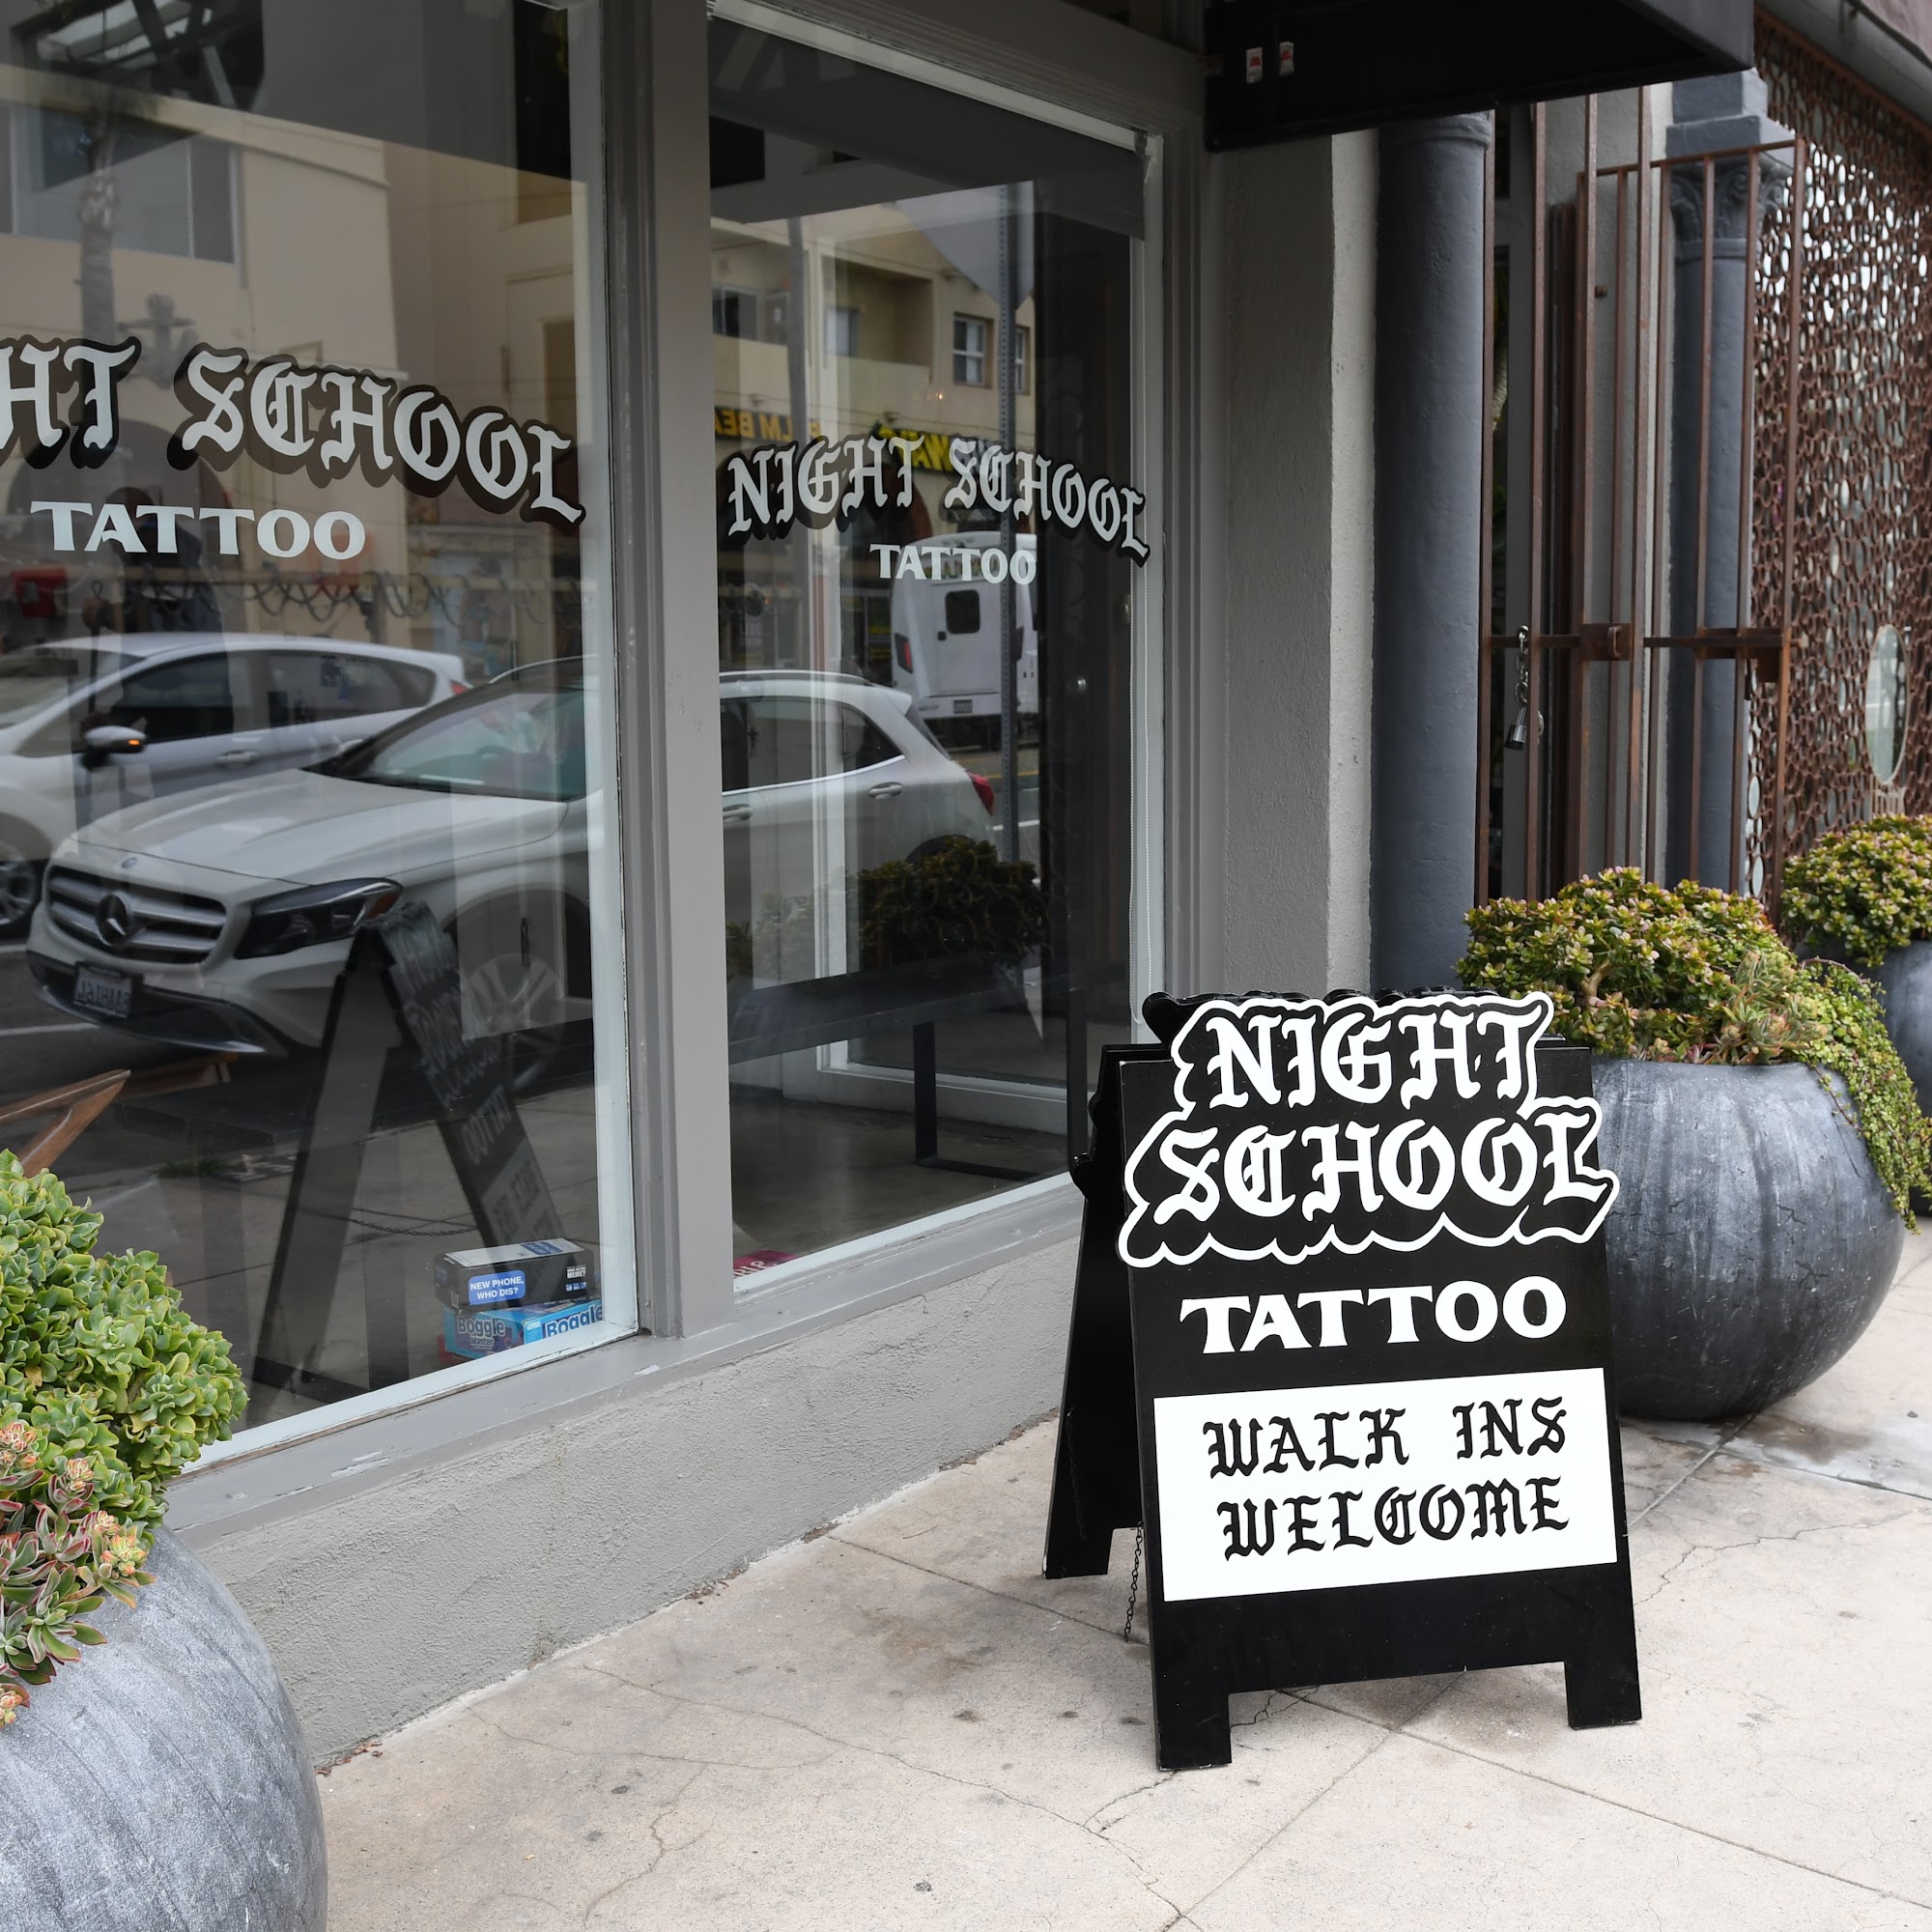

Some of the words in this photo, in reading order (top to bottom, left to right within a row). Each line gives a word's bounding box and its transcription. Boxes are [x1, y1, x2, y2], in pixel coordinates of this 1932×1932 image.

[181, 348, 582, 524] SCHOOL
[30, 500, 366, 560] TATTOO
[726, 435, 924, 536] NIGHT
[944, 437, 1150, 558] SCHOOL
[869, 544, 1037, 585] TATTOO
[1205, 1002, 1543, 1110] NIGHT
[1152, 1111, 1608, 1225] SCHOOL
[469, 1280, 491, 1291] NEW
[476, 1290, 497, 1300] WHO
[498, 1287, 519, 1296] DIS?
[1179, 1275, 1567, 1354] TATTOO
[456, 1315, 506, 1338] Boggle
[469, 1336, 496, 1348] Master
[1202, 1406, 1410, 1480] WALK
[1452, 1396, 1568, 1461] INS
[1216, 1475, 1570, 1562] WELCOME
